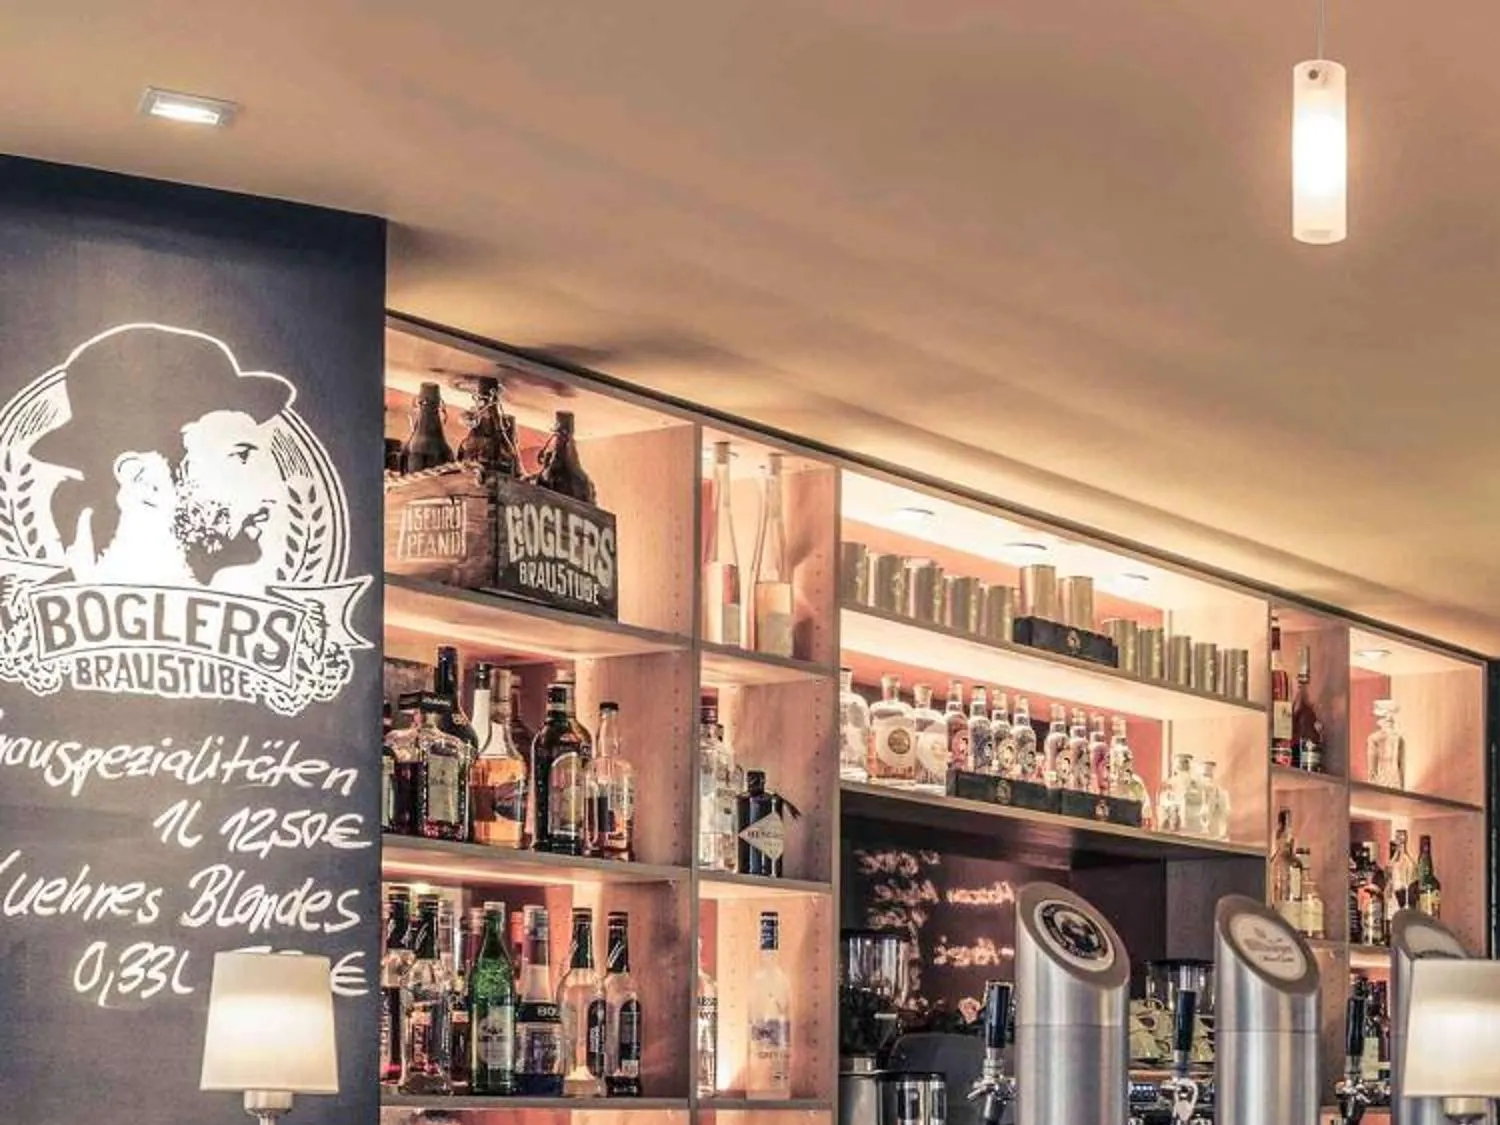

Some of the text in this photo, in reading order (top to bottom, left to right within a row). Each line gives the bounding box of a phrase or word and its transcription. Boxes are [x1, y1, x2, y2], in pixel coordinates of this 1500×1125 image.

[407, 531, 461, 557] PFAND
[505, 504, 615, 592] BOGLERS
[519, 560, 600, 605] BRAUSTUBE
[36, 590, 298, 673] BOGLERS
[75, 652, 252, 699] BRAUSTUBE
